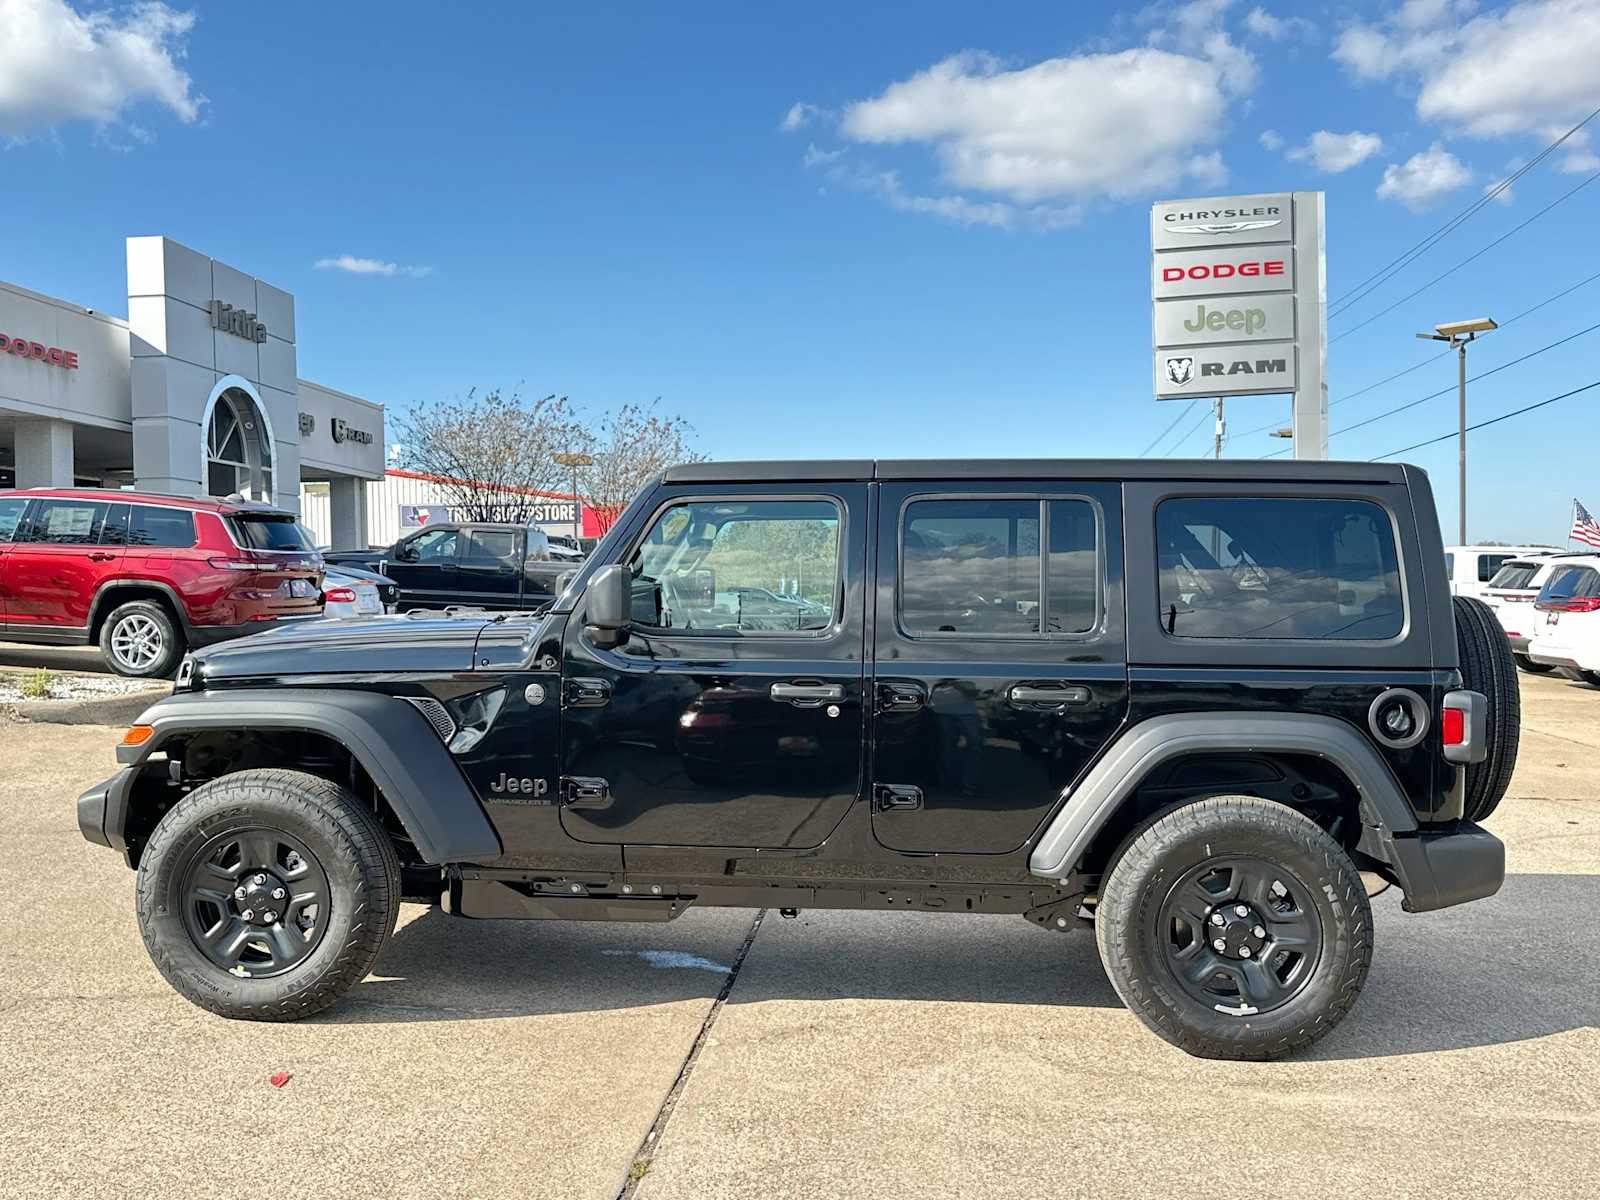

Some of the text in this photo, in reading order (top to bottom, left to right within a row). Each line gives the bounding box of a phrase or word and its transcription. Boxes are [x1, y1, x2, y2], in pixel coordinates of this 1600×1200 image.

[1164, 207, 1280, 222] CHRYSLER
[1163, 261, 1285, 282] DODGE
[1184, 305, 1266, 335] Jeep
[1201, 359, 1286, 377] RAM
[344, 427, 374, 445] RAM
[490, 772, 548, 797] Jeep
